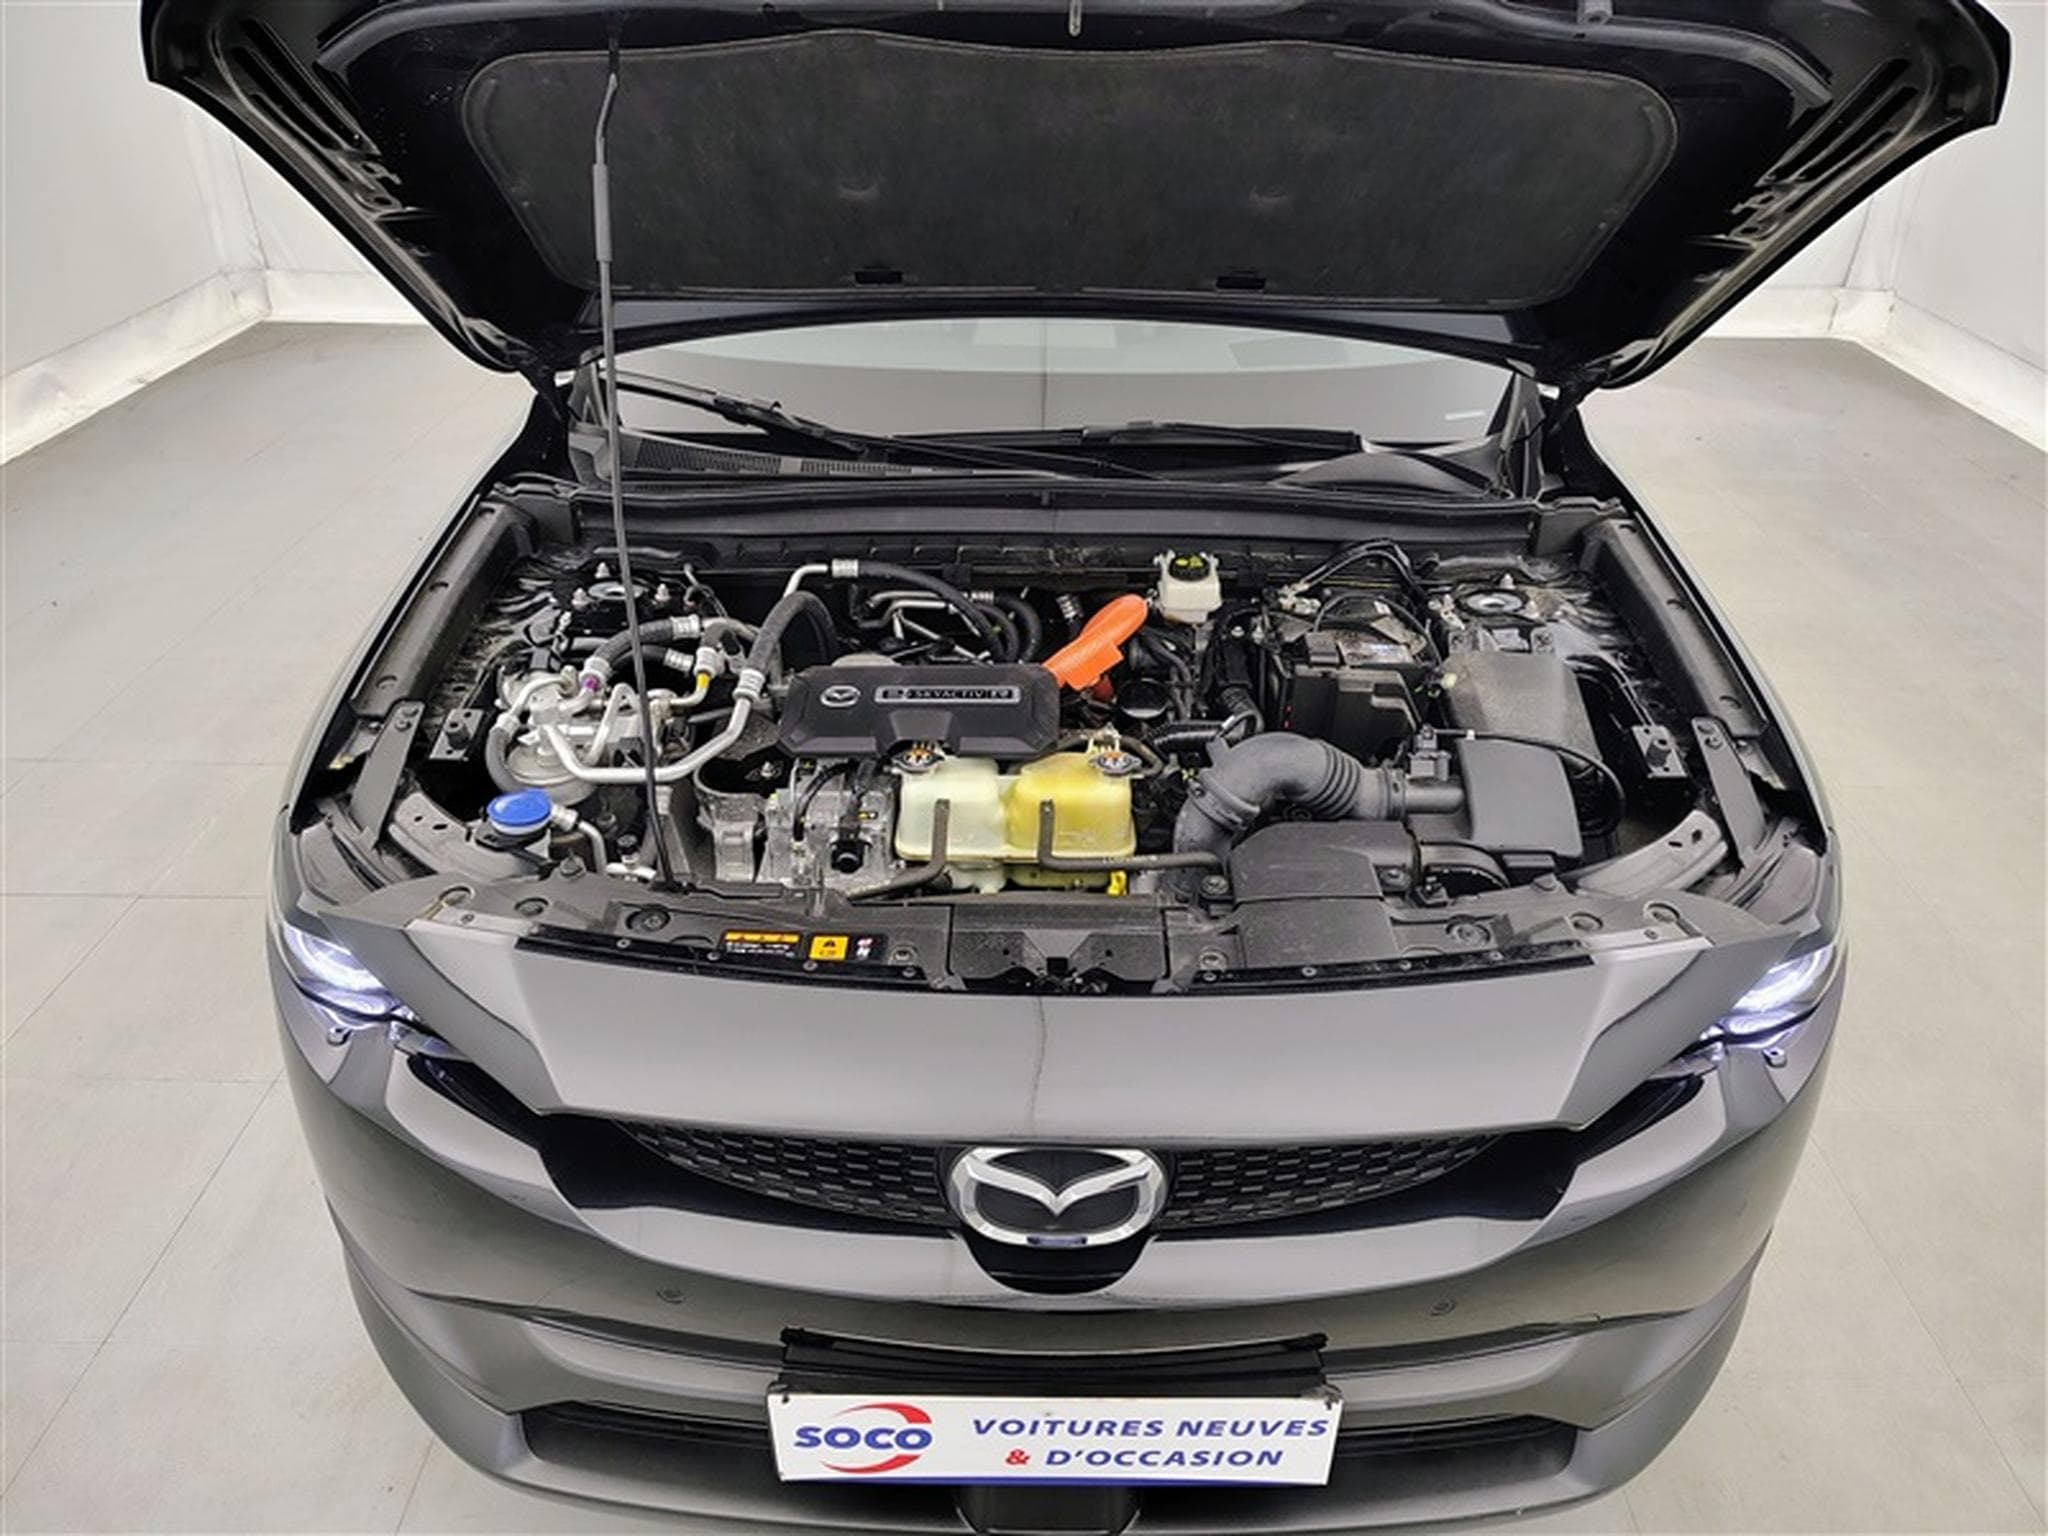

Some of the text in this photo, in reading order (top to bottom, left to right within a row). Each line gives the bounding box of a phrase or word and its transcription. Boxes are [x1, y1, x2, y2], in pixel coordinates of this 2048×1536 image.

[973, 1419, 1329, 1437] VOITURES NEUVES
[794, 1426, 933, 1451] SOCO
[1005, 1449, 1283, 1467] & D'OCCASION
